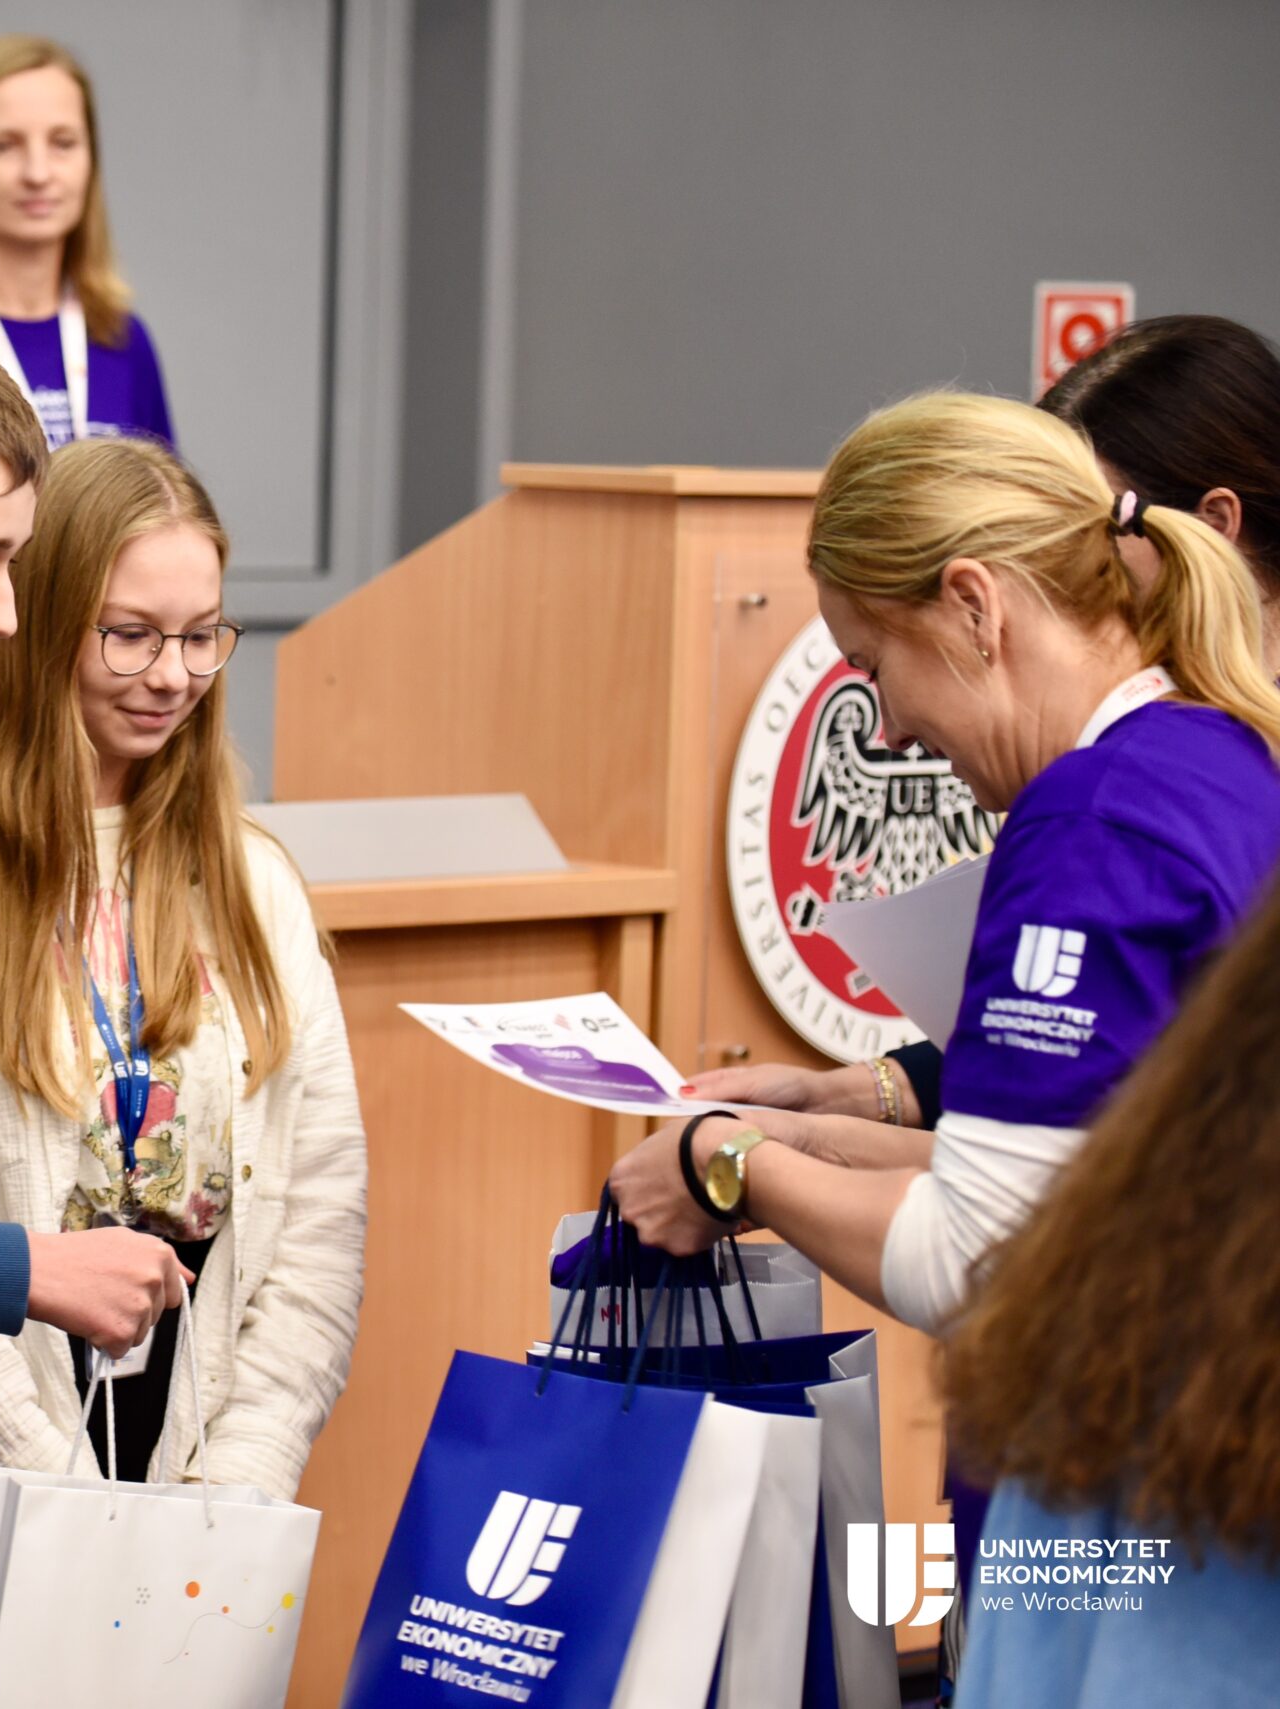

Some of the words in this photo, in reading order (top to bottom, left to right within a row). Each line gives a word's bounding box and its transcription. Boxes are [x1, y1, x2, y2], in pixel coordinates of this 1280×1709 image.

[891, 777, 933, 814] UE
[741, 770, 882, 1052] UNIVERSITAS
[1012, 923, 1087, 998] UE
[465, 1489, 582, 1606] UE
[396, 1619, 557, 1680] EKONOMICZNY
[409, 1594, 566, 1652] UNIWERSYTET
[400, 1654, 429, 1675] we
[431, 1657, 531, 1703] Wrocławiu
